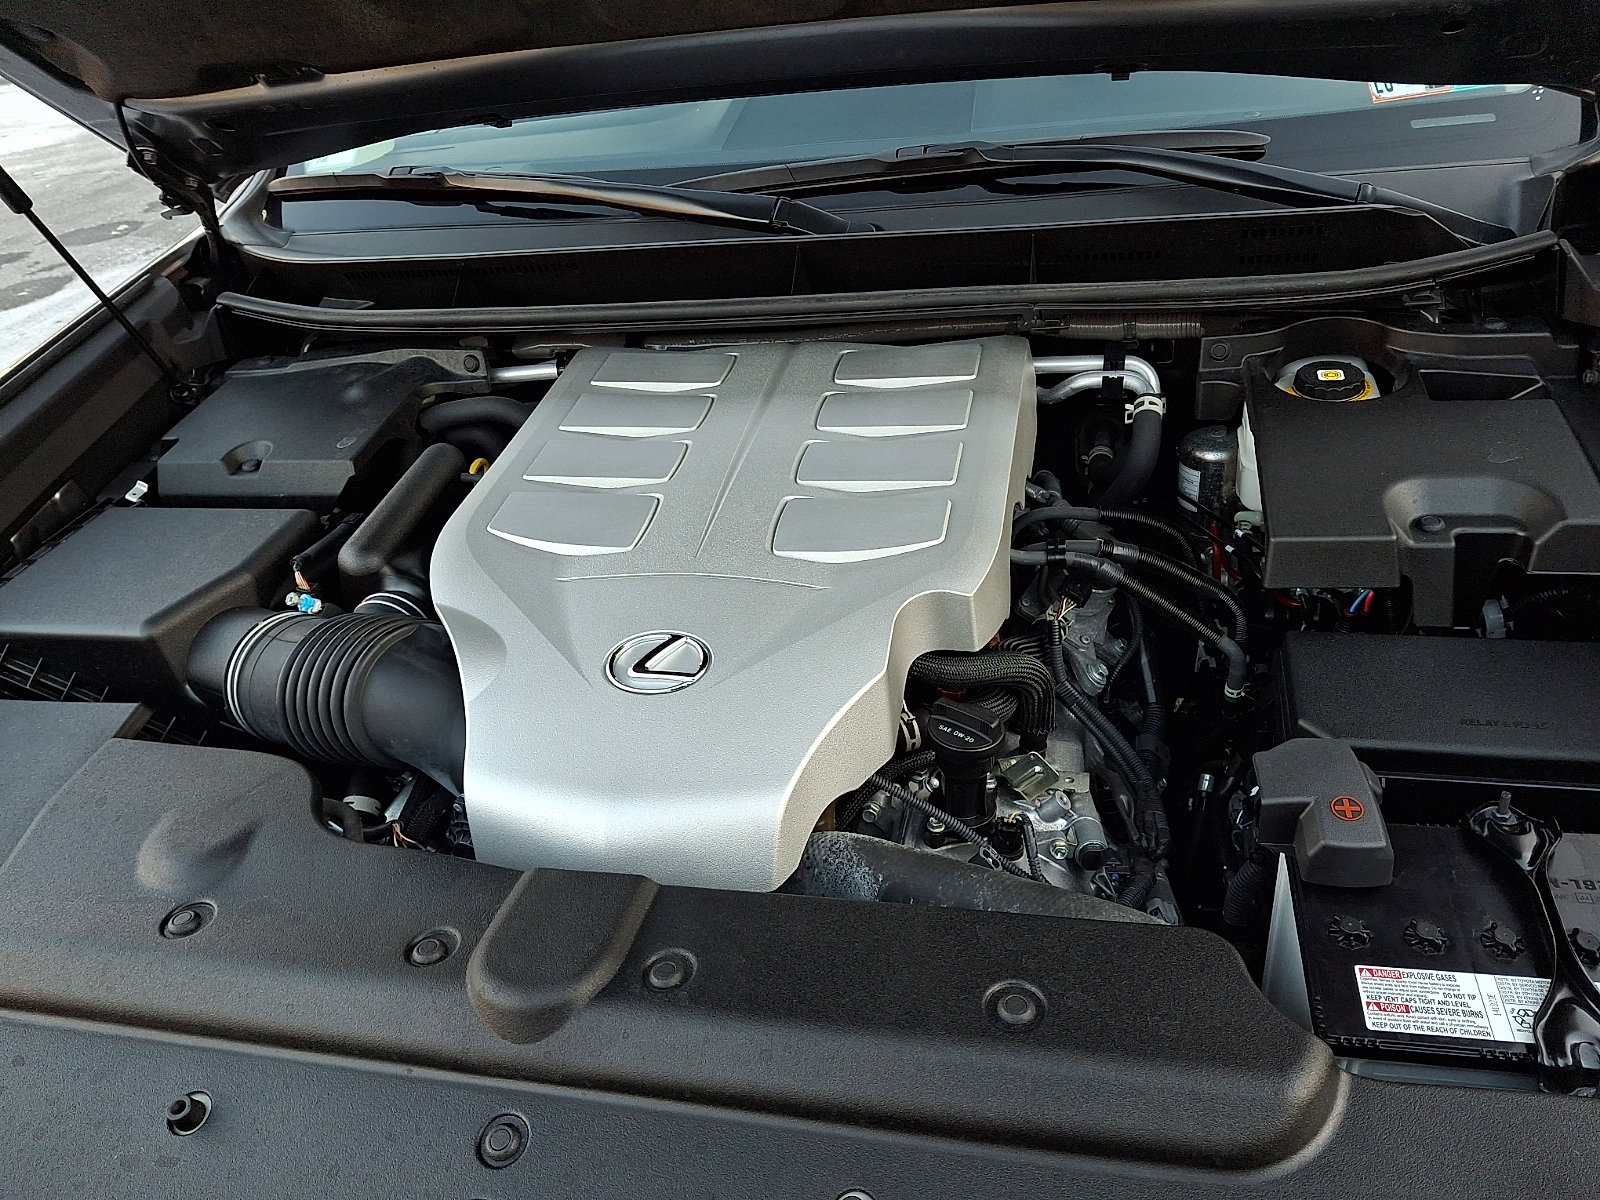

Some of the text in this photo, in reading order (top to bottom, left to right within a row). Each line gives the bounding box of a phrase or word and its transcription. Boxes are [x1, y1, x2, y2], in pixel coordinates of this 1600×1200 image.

[938, 724, 952, 734] SAE
[1373, 969, 1457, 983] DANGER EXPLOSIVE GASES
[1383, 995, 1399, 1003] VENT
[1400, 996, 1417, 1004] CAPS
[1418, 998, 1436, 1006] TIGHT
[1451, 1000, 1472, 1009] LEVEL
[1380, 1003, 1484, 1019] POISON CAUSES SEVERE BURNS
[1371, 1021, 1388, 1029] KEEP
[1389, 1022, 1402, 1030] OUT
[1426, 1025, 1449, 1034] REACH
[1450, 1027, 1458, 1035] OF
[1459, 1028, 1492, 1038] CHILDREN
